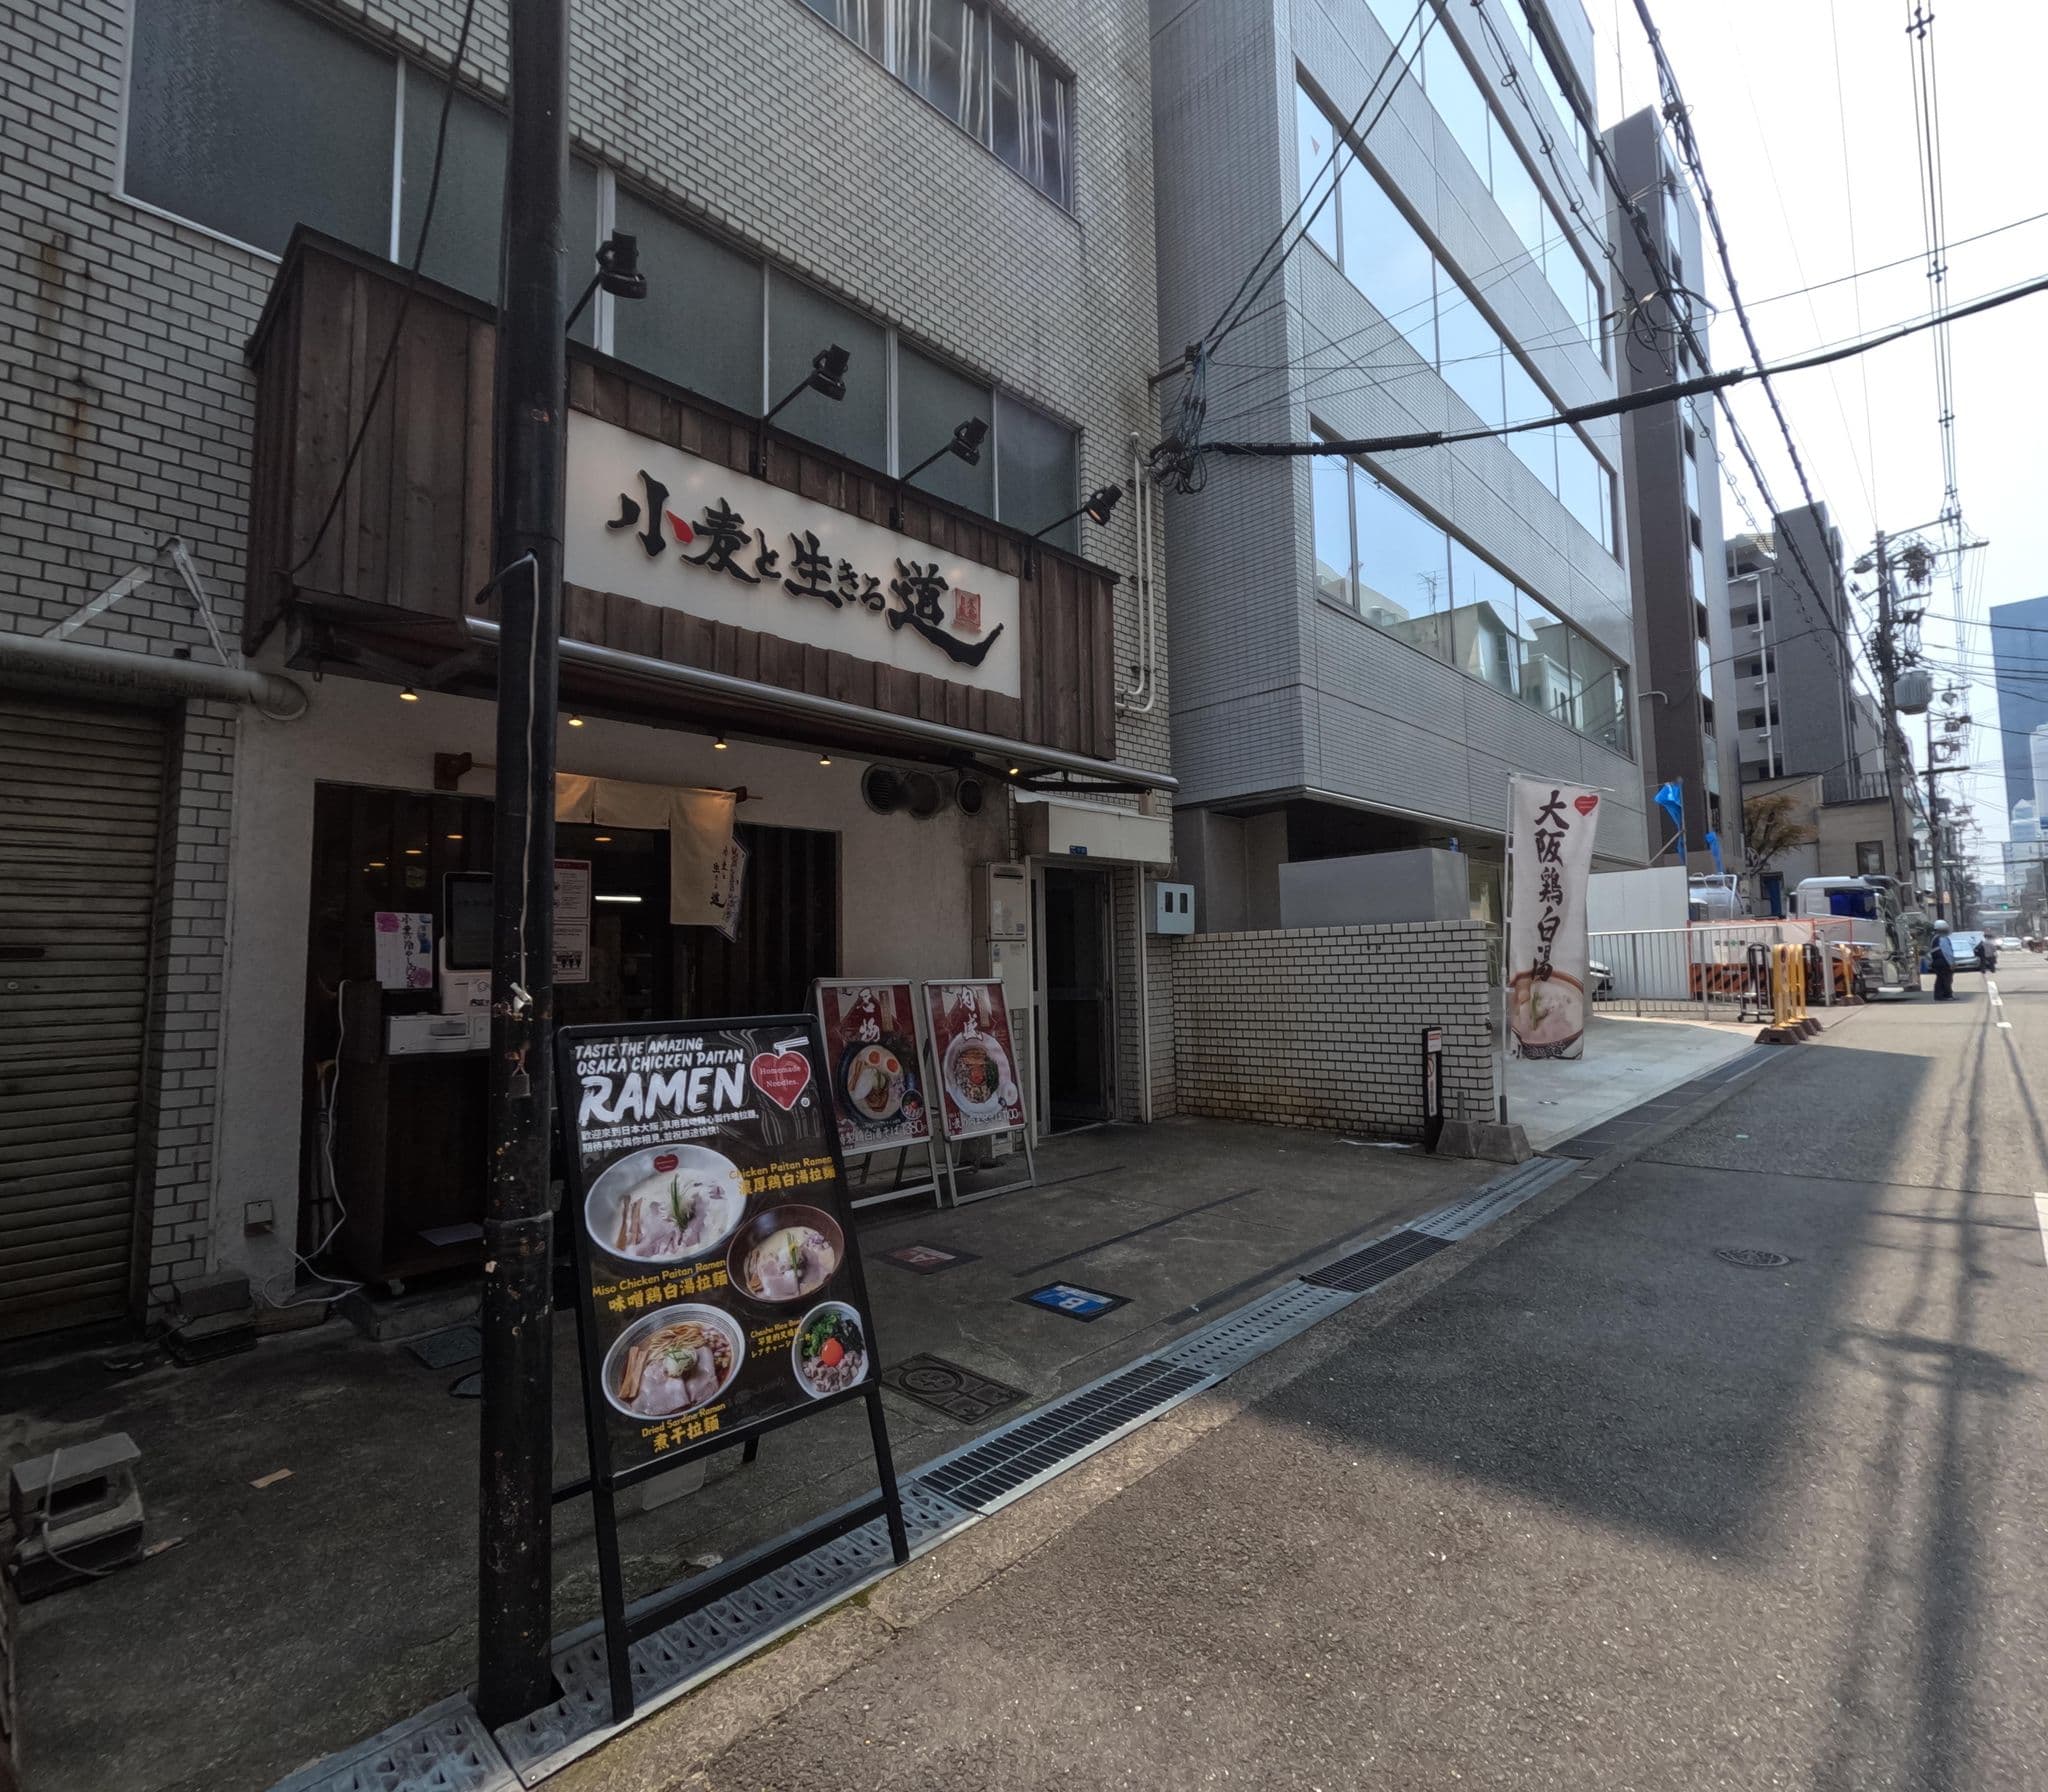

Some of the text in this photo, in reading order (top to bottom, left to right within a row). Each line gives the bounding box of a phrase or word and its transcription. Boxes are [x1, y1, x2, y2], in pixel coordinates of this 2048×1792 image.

[605, 468, 1005, 668] 小麦と生きる道
[1531, 789, 1570, 983] 大阪鶏白湯
[575, 1037, 704, 1060] TASTE THE AMAZING
[577, 1048, 744, 1075] OSAKA CHICKEN PAITAN
[579, 1063, 746, 1127] RAMEN
[729, 1156, 833, 1179] Chicken Paitan Ramen
[592, 1260, 726, 1297] Miso Chicken Paitan Ramen
[641, 1421, 665, 1437] Dried
[699, 1403, 726, 1416] Ramen
